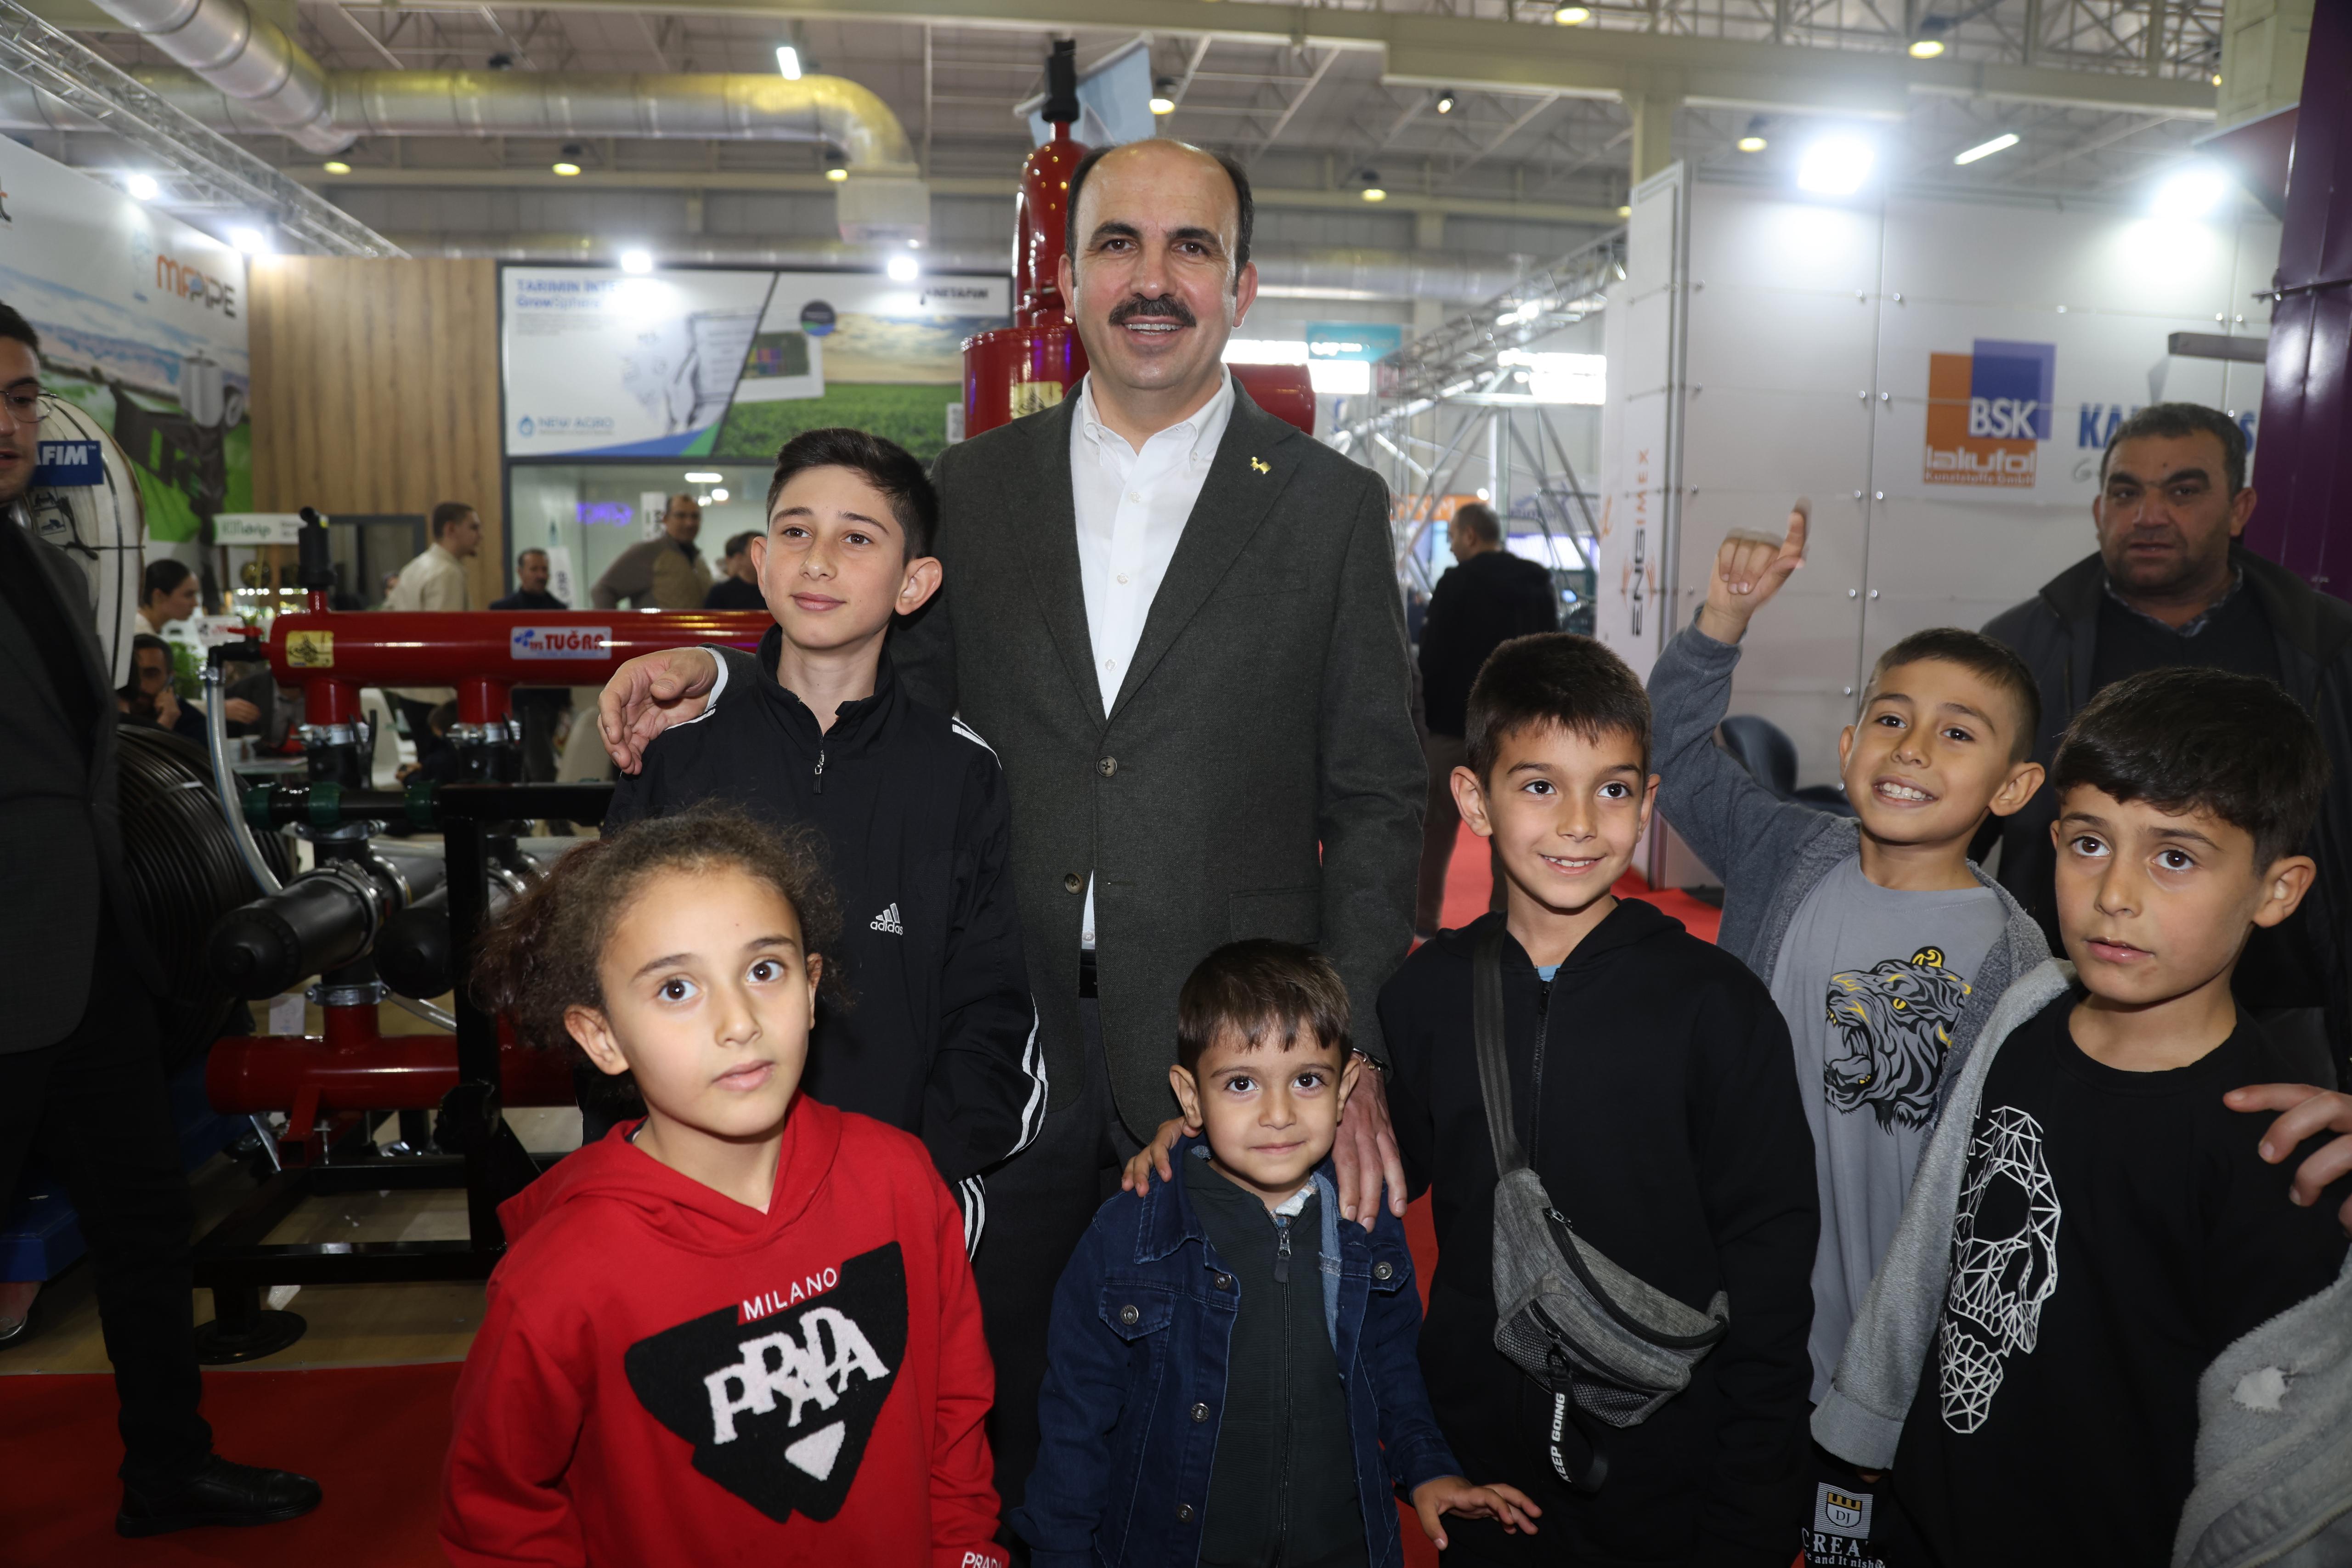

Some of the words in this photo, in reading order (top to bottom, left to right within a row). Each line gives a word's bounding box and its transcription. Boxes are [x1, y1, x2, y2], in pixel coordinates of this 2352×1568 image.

[538, 416, 572, 427] NEW
[575, 416, 615, 428] AGRO
[1969, 396, 2038, 438] BSK
[1632, 448, 1650, 636] ENGIMEX
[545, 630, 605, 650] TUĞRA
[870, 920, 903, 935] adidas
[742, 1267, 838, 1321] MILANO
[704, 1306, 890, 1445] PRADA
[1551, 1393, 1565, 1442] GOING
[1550, 1446, 1572, 1483] KEEP
[1836, 1510, 1851, 1524] DJ
[1802, 1528, 1869, 1557] CREA
[1815, 1556, 1835, 1565] and
[1838, 1556, 1848, 1566] It
